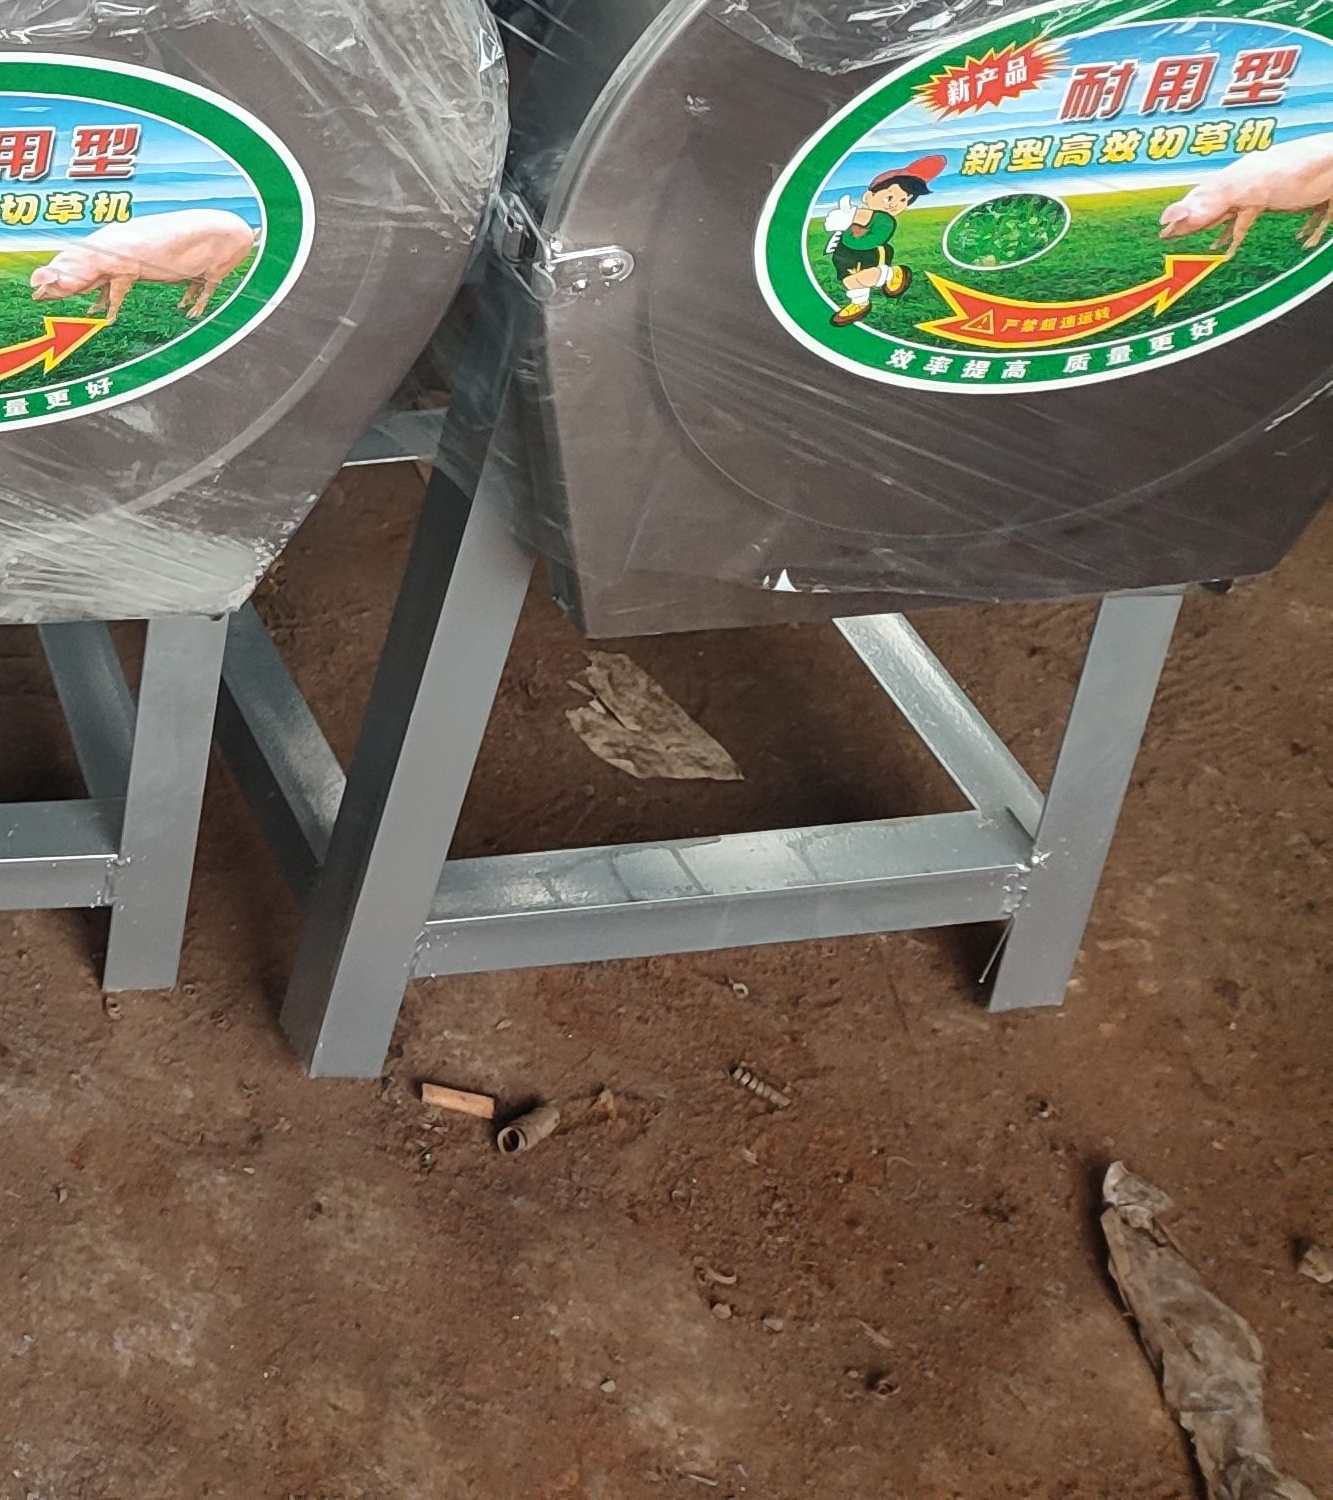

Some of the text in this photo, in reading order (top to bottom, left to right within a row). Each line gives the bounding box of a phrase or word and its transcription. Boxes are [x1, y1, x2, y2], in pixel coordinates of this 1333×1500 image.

[947, 54, 1030, 107] 新产品
[1059, 45, 1302, 122] 耐用型
[961, 117, 1279, 177] 新型高效切草机
[885, 316, 1218, 380] 效率提高 质量更好
